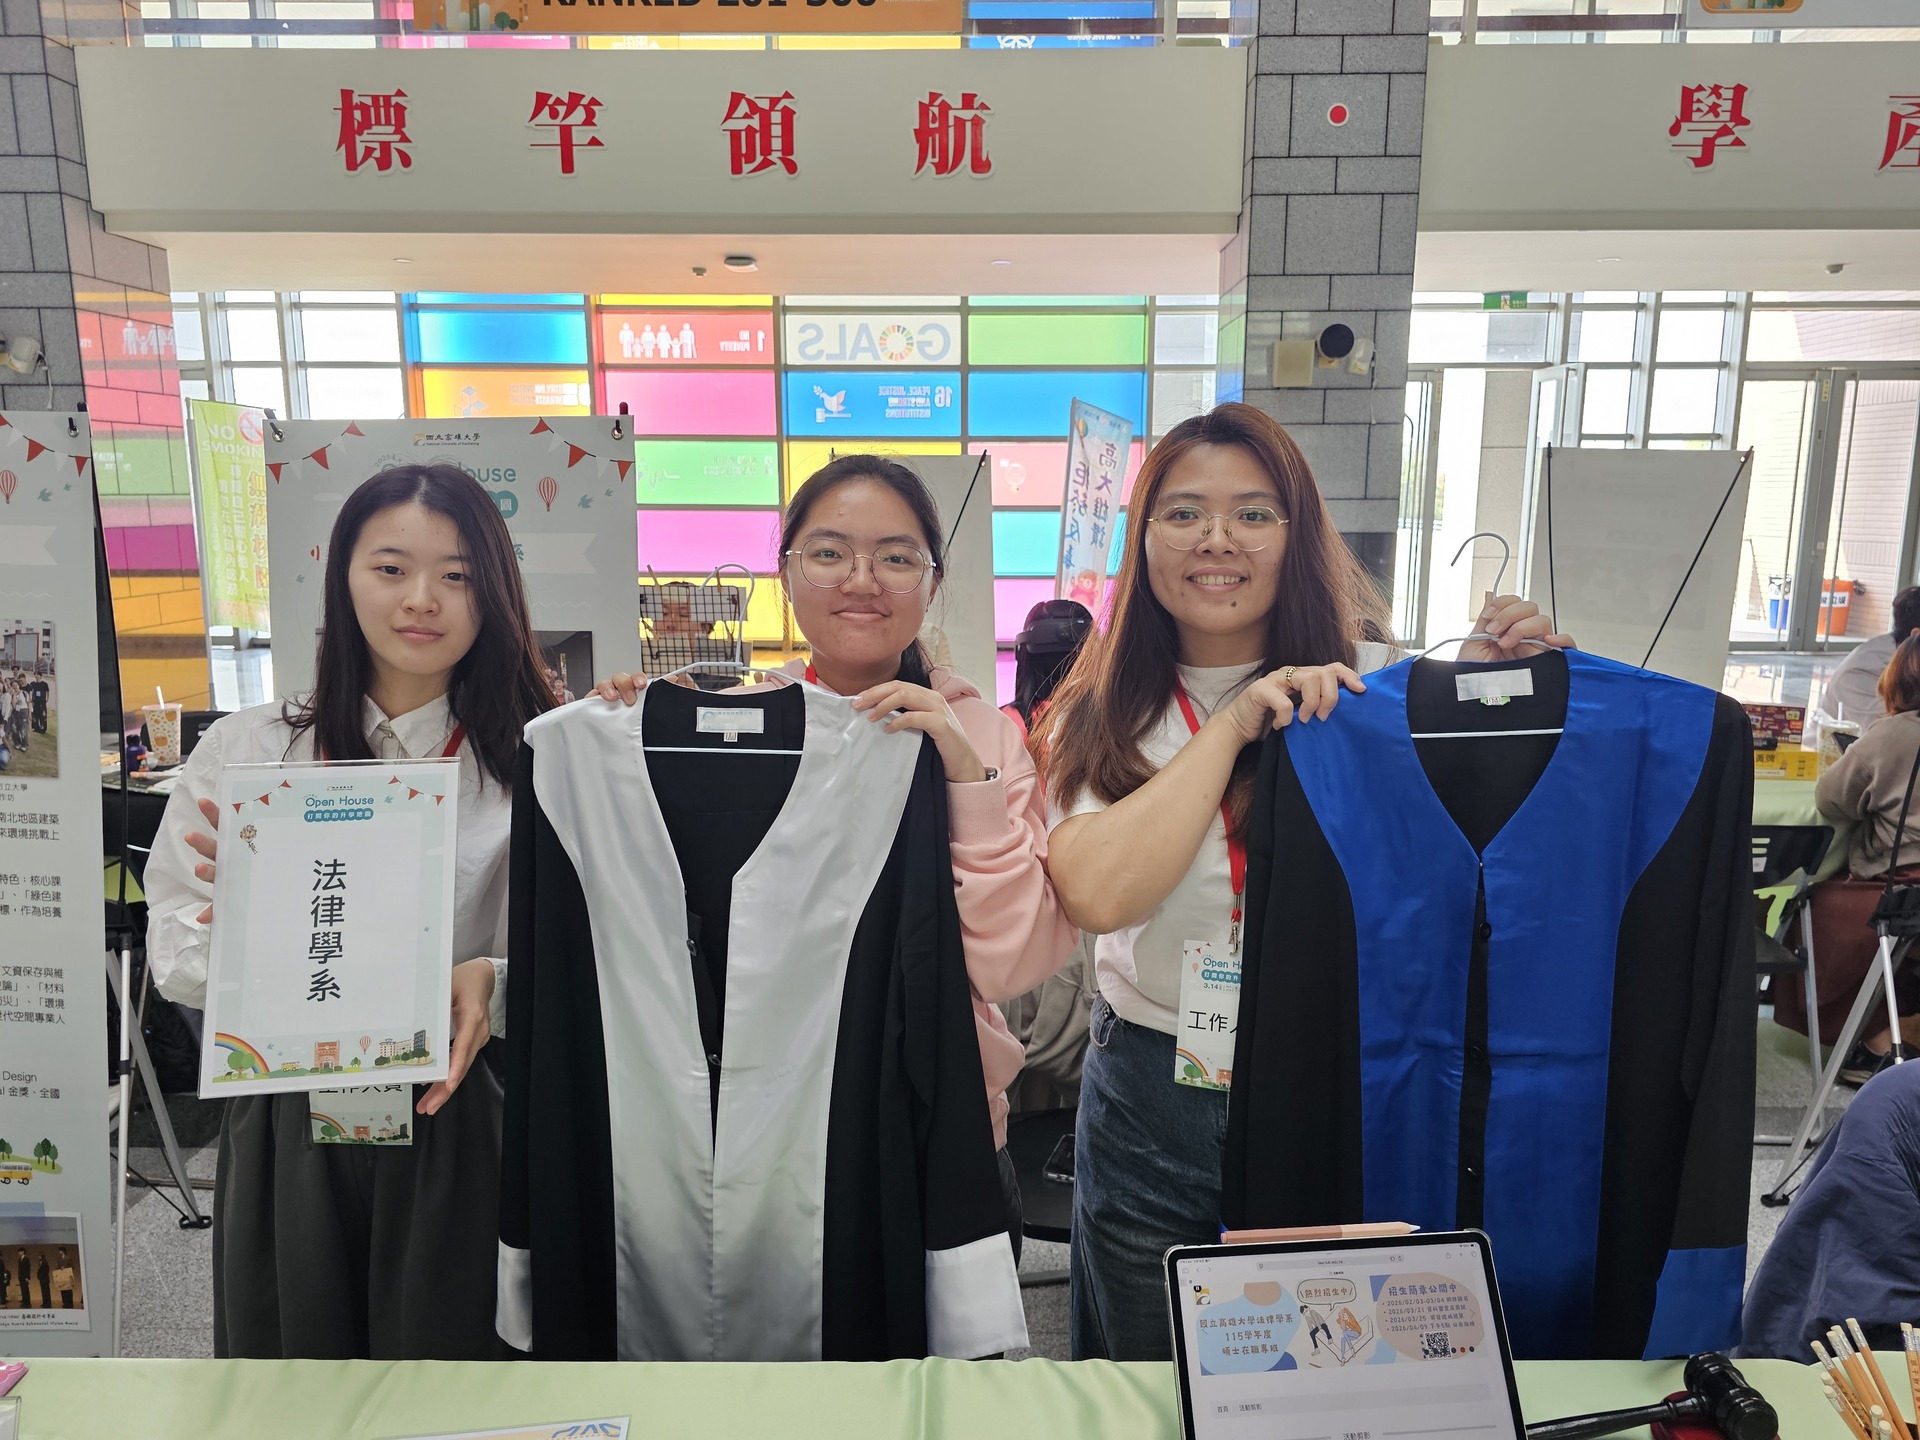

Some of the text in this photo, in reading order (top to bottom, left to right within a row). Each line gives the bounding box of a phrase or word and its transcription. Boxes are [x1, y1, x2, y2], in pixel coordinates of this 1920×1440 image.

[334, 87, 991, 176] 標竿領航
[458, 461, 517, 483] ouse
[305, 796, 374, 808] Open House
[307, 859, 347, 1002] 法律學系
[1203, 958, 1228, 968] Open
[0, 981, 64, 994] 論」、「材料
[0, 1011, 65, 1025] 代空間專業人
[2, 1070, 38, 1084] Design
[1200, 1313, 1294, 1328] 國立高雄大學法律學系
[1226, 1329, 1272, 1341] 115學年度
